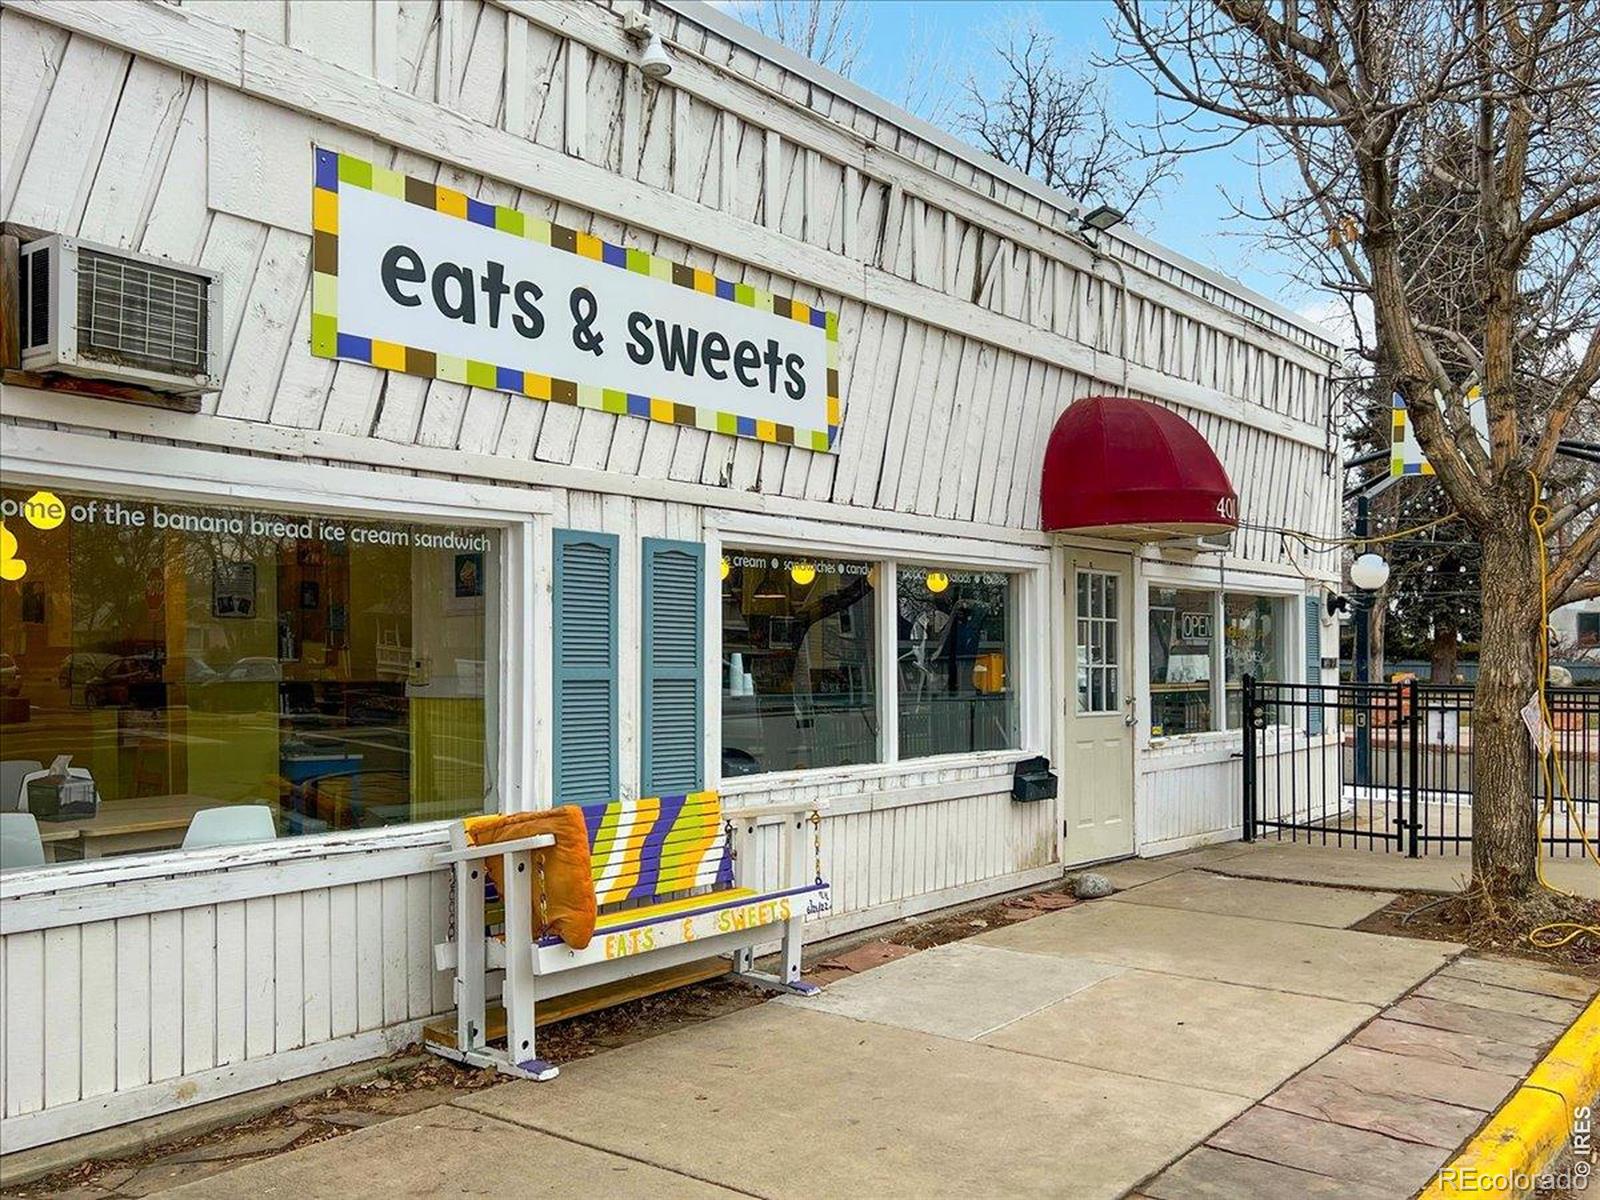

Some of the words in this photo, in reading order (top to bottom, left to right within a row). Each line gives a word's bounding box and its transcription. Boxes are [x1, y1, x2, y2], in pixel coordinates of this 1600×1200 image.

[381, 244, 544, 340] eats
[569, 286, 604, 357] &
[626, 311, 806, 400] sweets
[71, 501, 97, 523] of
[104, 503, 145, 526] the
[153, 506, 243, 534] banana
[251, 514, 312, 539] bread
[319, 522, 345, 542] ice
[351, 526, 409, 546] cream
[415, 531, 491, 552] sandwich
[733, 555, 766, 569] cream
[846, 563, 873, 579] candy
[1184, 615, 1213, 638] OPEN
[606, 927, 654, 960] EATS
[719, 898, 791, 932] SWEETS
